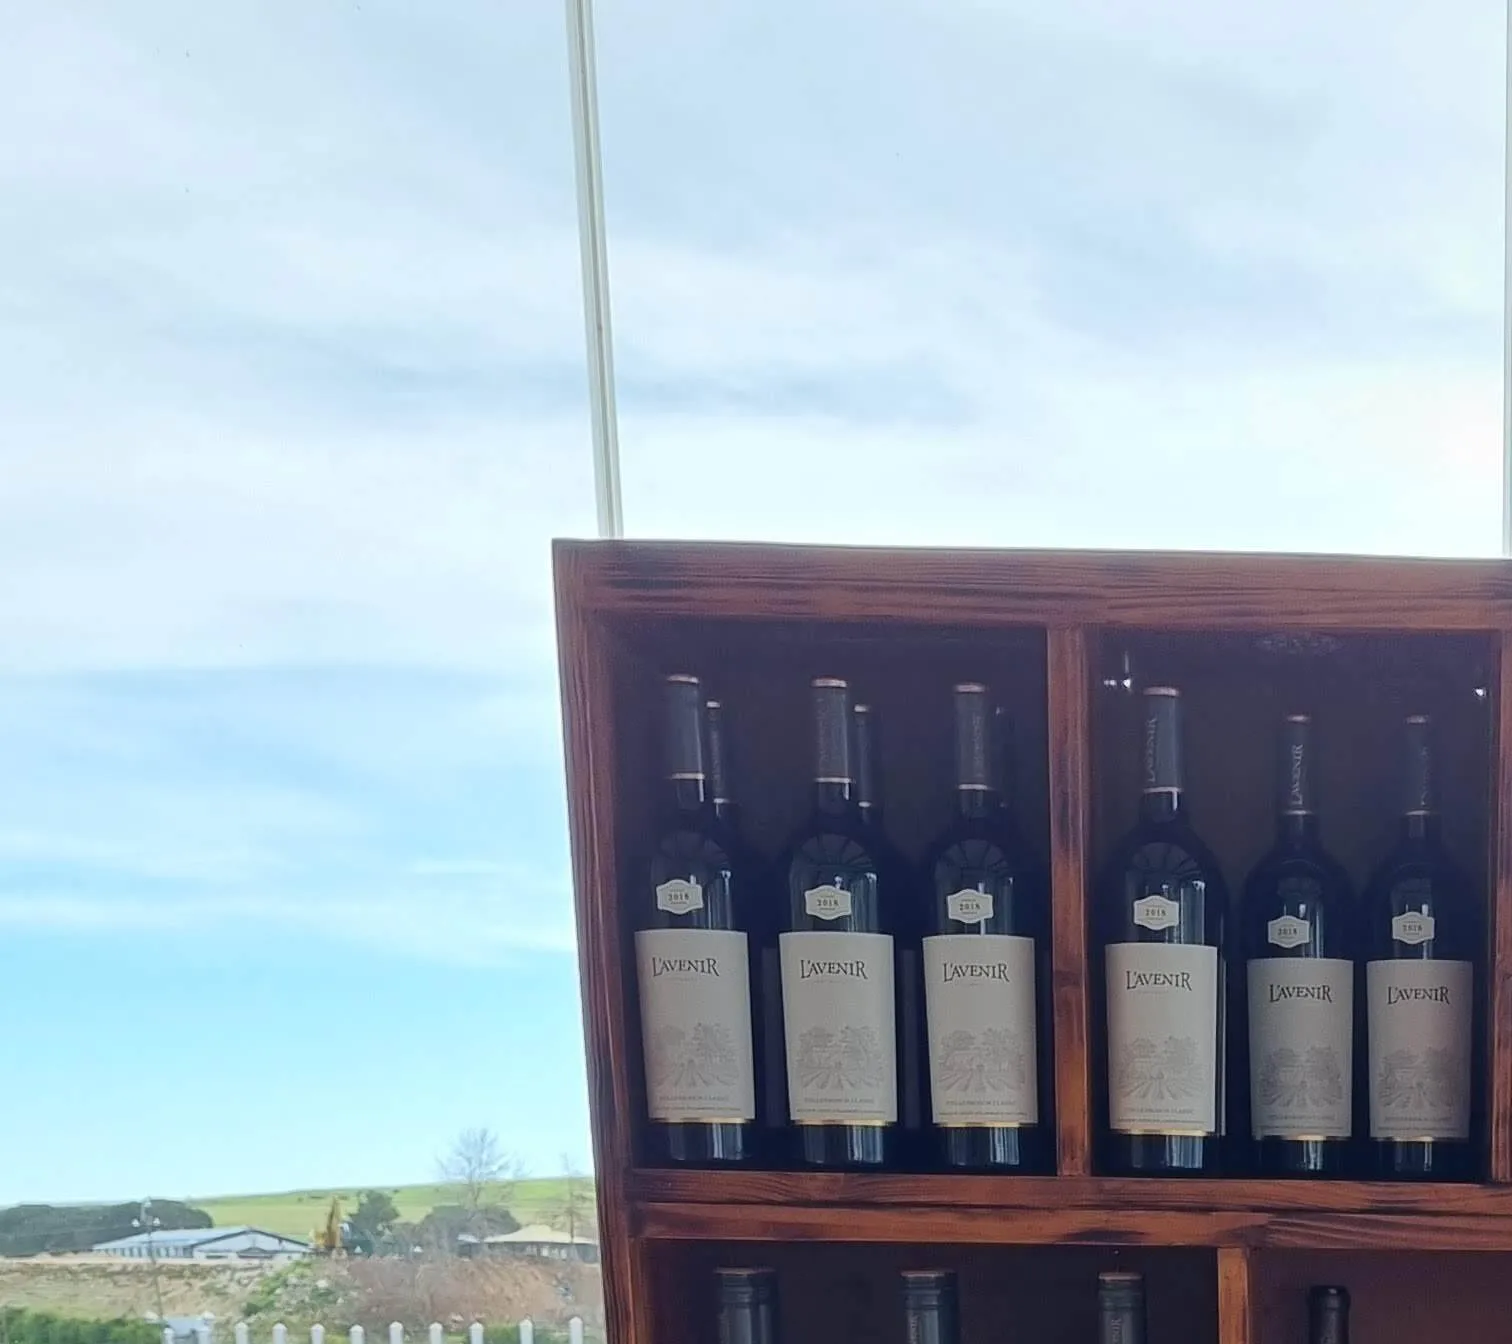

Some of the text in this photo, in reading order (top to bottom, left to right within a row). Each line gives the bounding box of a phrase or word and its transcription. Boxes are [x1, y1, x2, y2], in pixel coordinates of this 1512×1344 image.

[652, 957, 720, 977] L'AVENIR
[800, 959, 868, 979] L'AVENIR
[943, 962, 1010, 982] L'AVENIR
[1126, 970, 1192, 991] L'AVENIR
[1269, 984, 1332, 1003] L'AVENIR
[1387, 986, 1450, 1005] L'AVENIR
